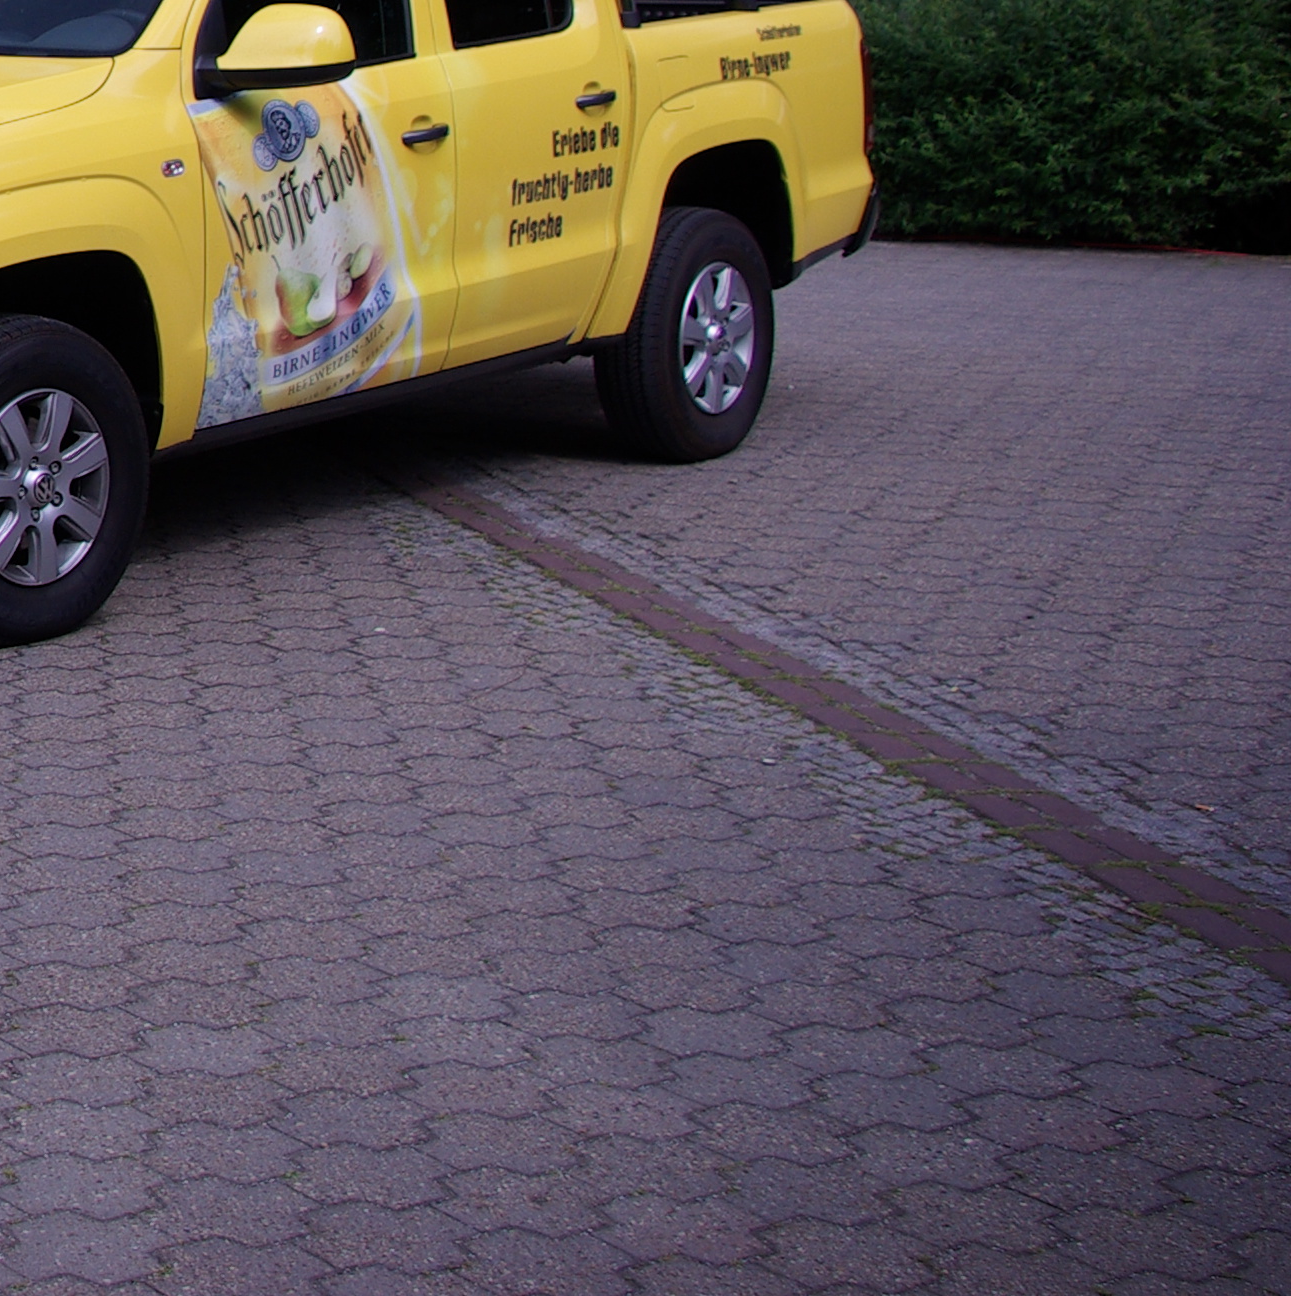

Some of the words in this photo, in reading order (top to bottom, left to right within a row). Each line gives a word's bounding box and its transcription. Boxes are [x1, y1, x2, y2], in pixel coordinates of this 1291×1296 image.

[719, 51, 791, 80] Birne-Ingwer
[552, 126, 597, 158] Erlebe
[600, 121, 620, 150] die
[512, 163, 613, 207] fruchtig-herbe
[508, 211, 563, 248] Frische
[272, 282, 392, 379] BIRNE-INGWER
[288, 322, 385, 396] HEFEWEIZEN-MIX
